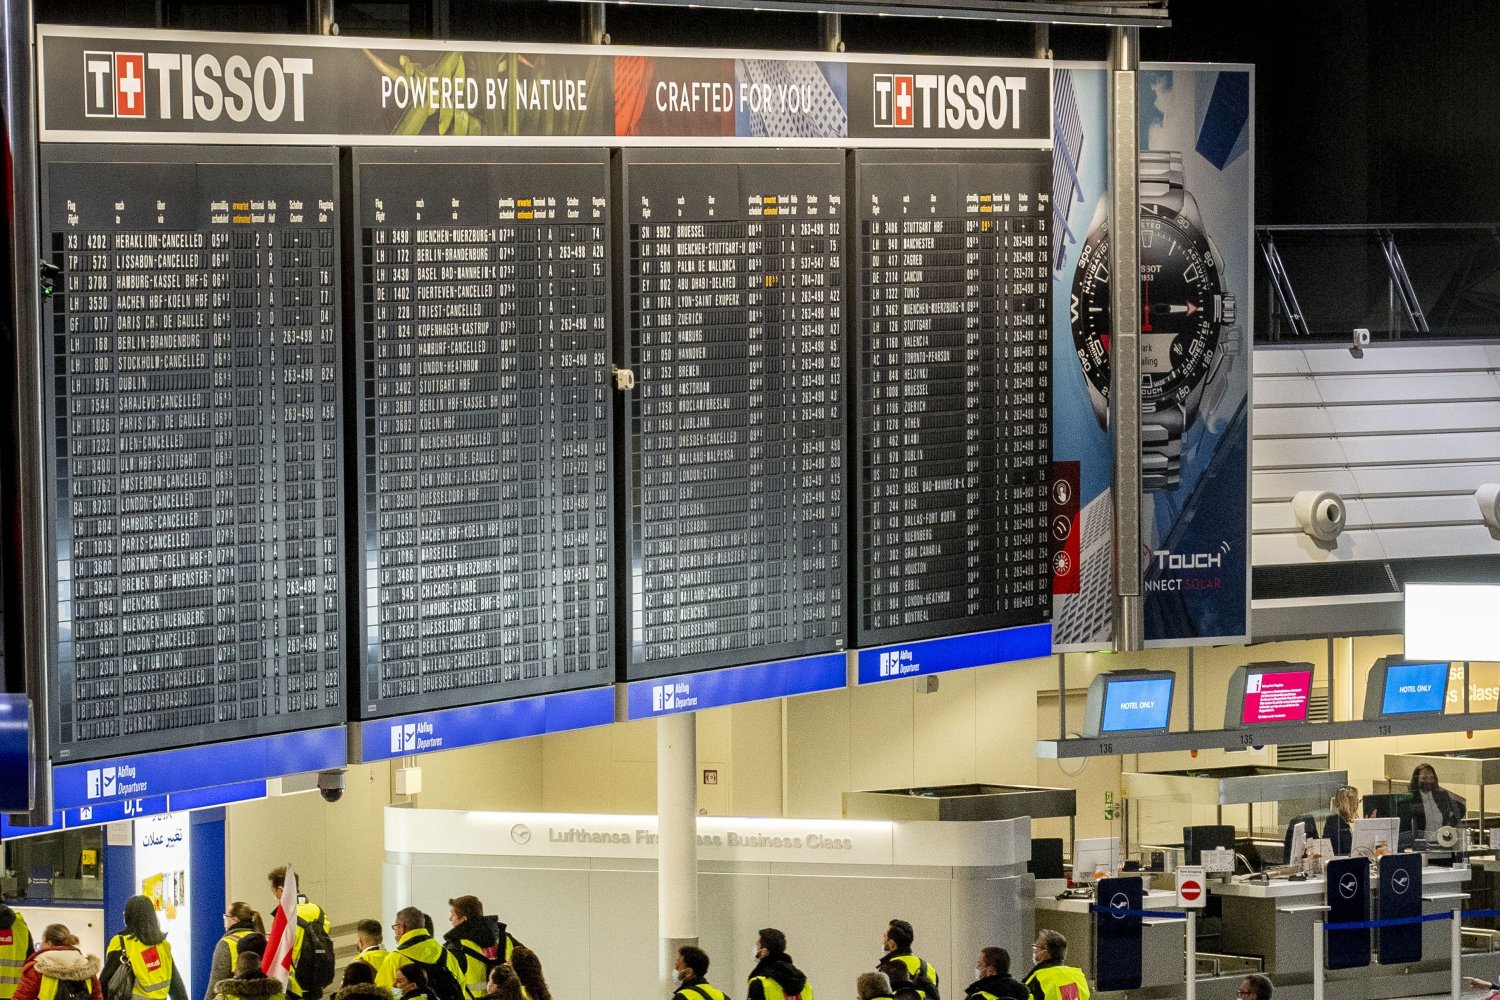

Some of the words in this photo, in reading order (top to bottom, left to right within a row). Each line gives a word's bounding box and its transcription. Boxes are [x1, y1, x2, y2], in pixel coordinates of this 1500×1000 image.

[148, 53, 313, 122] TISSOT
[381, 75, 479, 110] POWERED
[486, 80, 508, 110] BY
[515, 79, 588, 111] NATURE
[655, 81, 734, 113] CRAFTED
[740, 83, 772, 113] FOR
[777, 84, 811, 113] YOU
[915, 74, 1026, 130] TISSOT
[87, 234, 106, 248] 4202
[115, 233, 203, 248] HERAKLION-CANCELLED
[116, 252, 199, 269] LISSABON-CANCELLED
[417, 248, 489, 262] BERLIN-BRANDENBURG
[1078, 244, 1092, 268] 300
[1187, 248, 1210, 290] ACTIVITY
[417, 284, 493, 299] FUERTEVEN-CANCELLED
[418, 303, 482, 318] TRIEST-CANCELLED
[418, 322, 490, 337] KOPENHAGEN-KASTRUP
[117, 333, 200, 350] BERLIN-BRANDENBURG
[320, 328, 333, 343] A17
[1182, 321, 1210, 376] CONNECTED
[118, 352, 205, 371] STOCKHOLM-CANCELLED
[1078, 349, 1091, 372] 240
[1203, 349, 1213, 369] 120
[118, 376, 147, 392] DUBLIN
[1176, 385, 1190, 400] 150
[121, 471, 207, 493] AMSTERDAM-CANCELLED
[121, 493, 194, 513] LONDON-CANCELLED
[121, 512, 198, 533] HAMBURG-CANCELLED
[122, 533, 190, 552] PARIS-CANCELLED
[1184, 578, 1221, 590] SOLAR
[675, 683, 690, 696] Abflug
[1399, 685, 1416, 694] HOTEL
[1417, 684, 1432, 693] ONLY
[675, 695, 698, 709] Departures
[1120, 701, 1138, 710] HOTEL
[1139, 700, 1155, 709] ONLY
[417, 722, 433, 734] Abflug
[417, 737, 442, 750] Departures
[1099, 743, 1113, 755] 136
[118, 765, 136, 778] Abflug
[118, 781, 147, 795] Departures
[549, 828, 630, 844] Lufthansa
[728, 832, 801, 848] Business
[806, 834, 852, 850] Class
